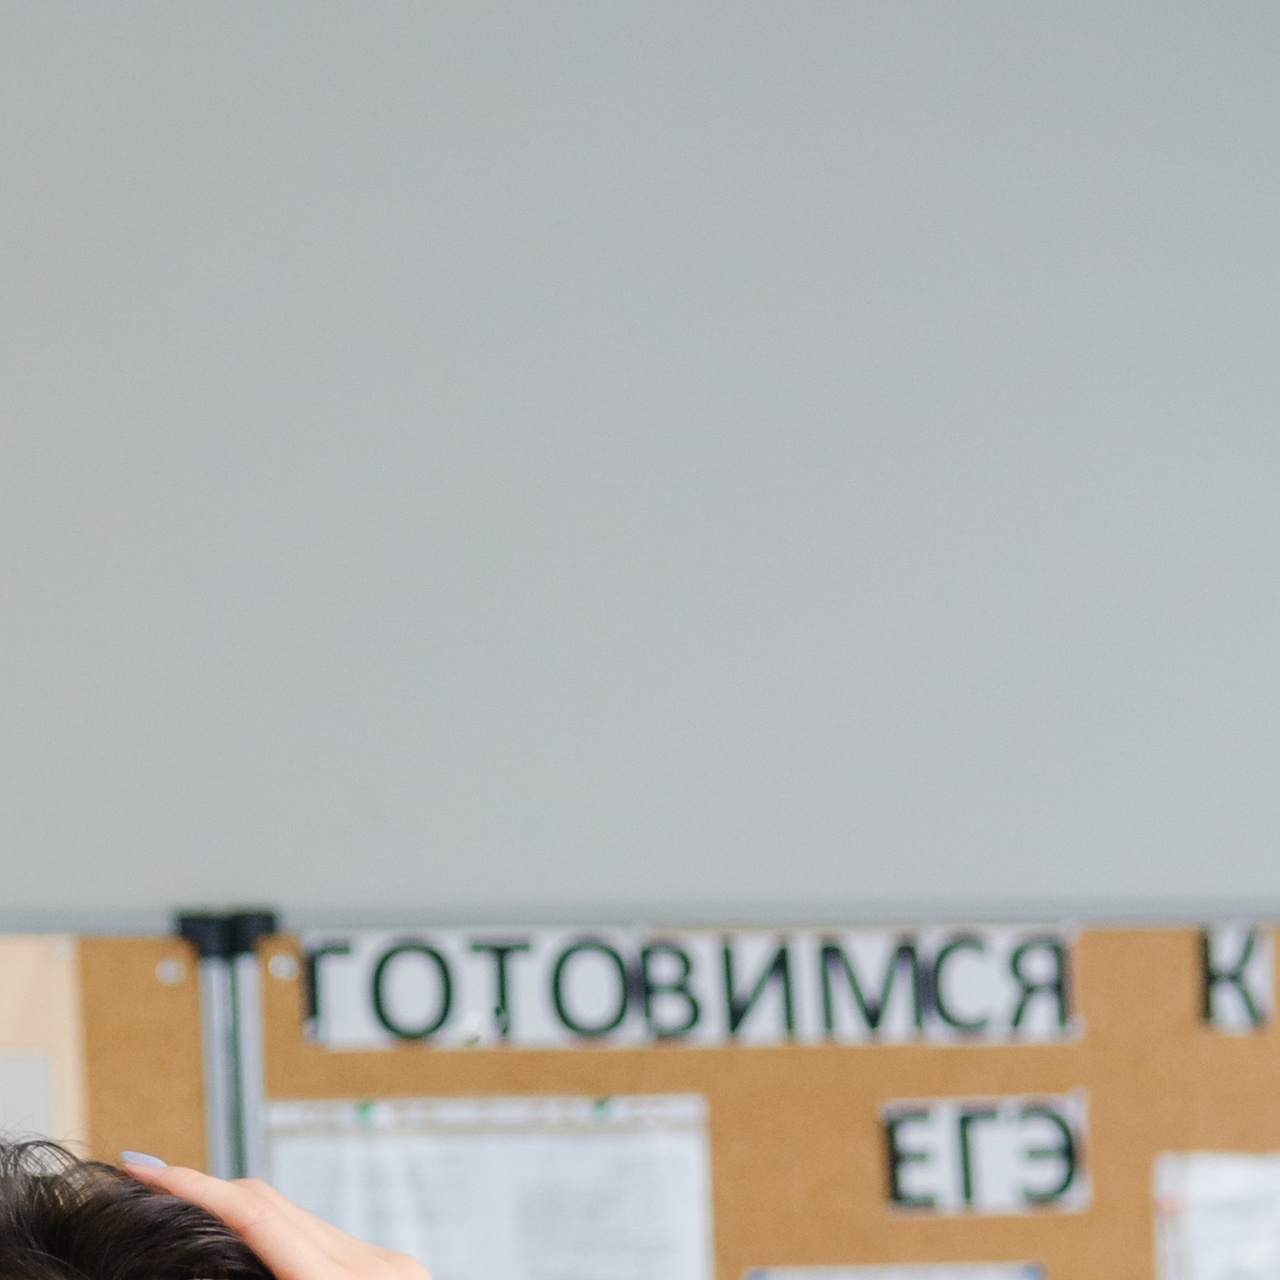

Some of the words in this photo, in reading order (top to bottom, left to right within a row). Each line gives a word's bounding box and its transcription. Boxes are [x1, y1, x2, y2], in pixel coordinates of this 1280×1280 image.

[303, 934, 1072, 1042] ГОТОВИМСЯ
[1197, 924, 1265, 1028] К
[884, 1104, 1081, 1209] ЕГЭ
